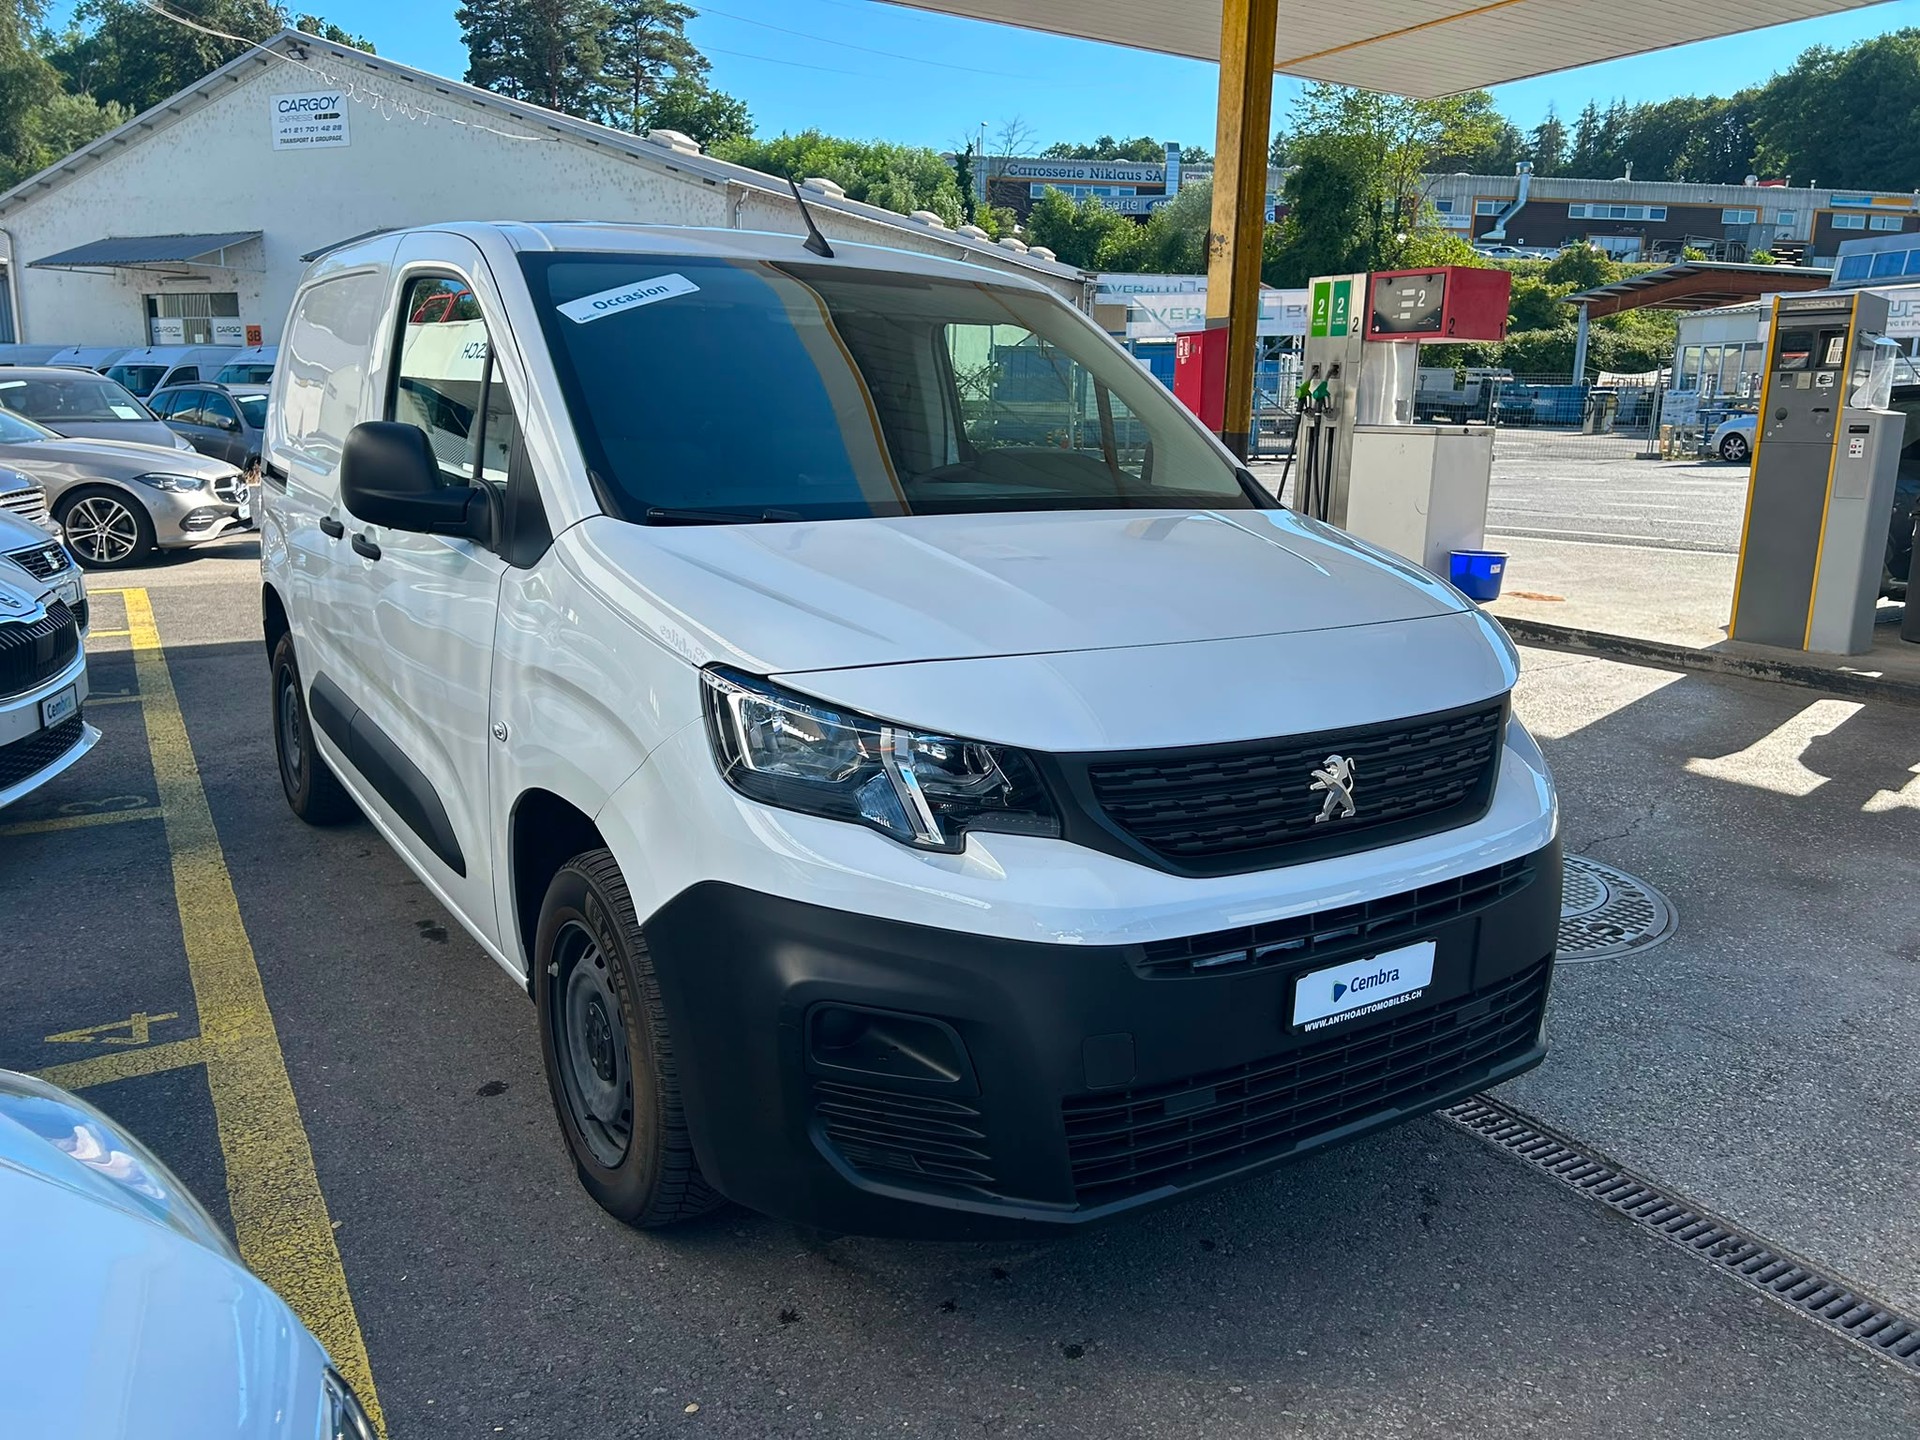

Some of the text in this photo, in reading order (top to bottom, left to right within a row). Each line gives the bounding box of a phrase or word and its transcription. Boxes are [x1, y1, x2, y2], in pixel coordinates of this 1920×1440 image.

[278, 96, 340, 113] CARGOY
[279, 114, 313, 123] EXPRESS
[1008, 164, 1163, 182] Carrosserie Niklaus SA
[592, 285, 670, 310] Occasion
[1336, 297, 1344, 314] 2
[1417, 290, 1426, 307] 2
[1152, 308, 1201, 320] VER
[1318, 298, 1325, 315] 2
[1352, 316, 1359, 333] 2
[1448, 317, 1455, 334] 2
[1500, 321, 1504, 338] 1
[247, 330, 262, 341] 3B
[1350, 968, 1400, 993] Cembra
[1304, 989, 1423, 1032] WWW.ANTHOAUTOMOBILES.CH
[44, 1012, 179, 1045] 4
